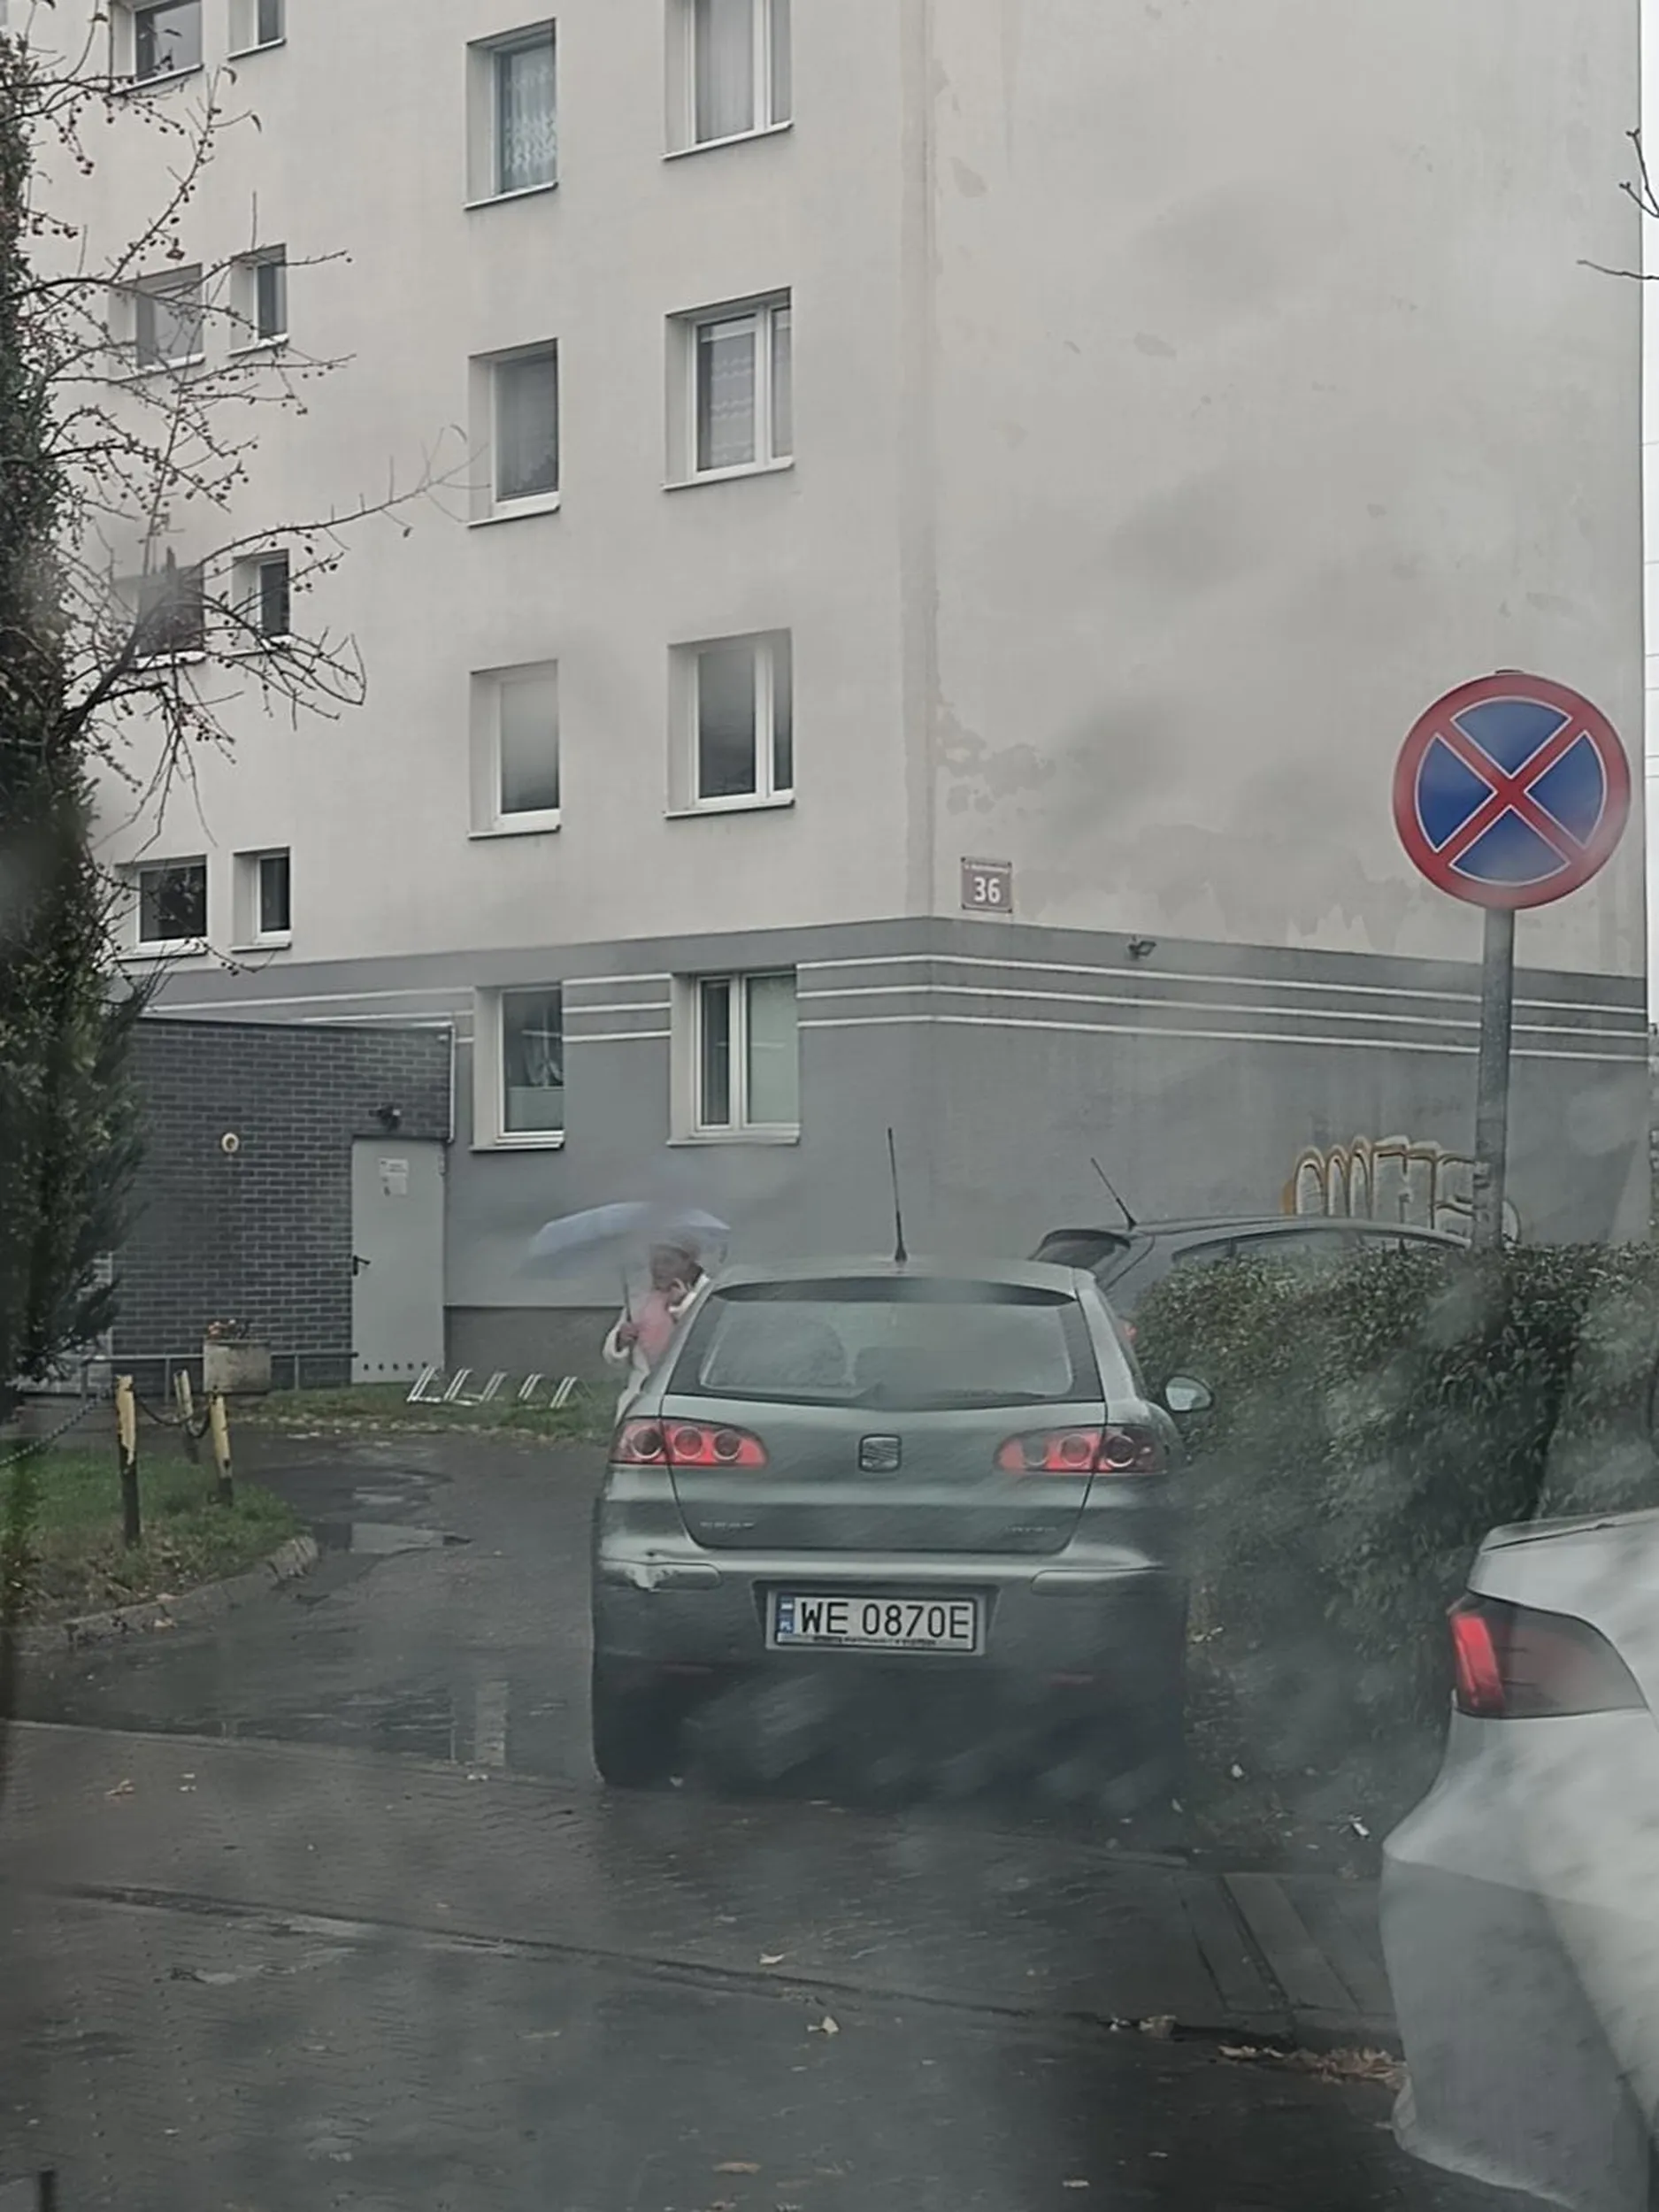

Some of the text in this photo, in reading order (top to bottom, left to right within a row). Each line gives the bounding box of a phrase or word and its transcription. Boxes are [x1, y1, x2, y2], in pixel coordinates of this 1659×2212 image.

[974, 877, 1002, 903] 36
[801, 1601, 970, 1640] WE 0870E
